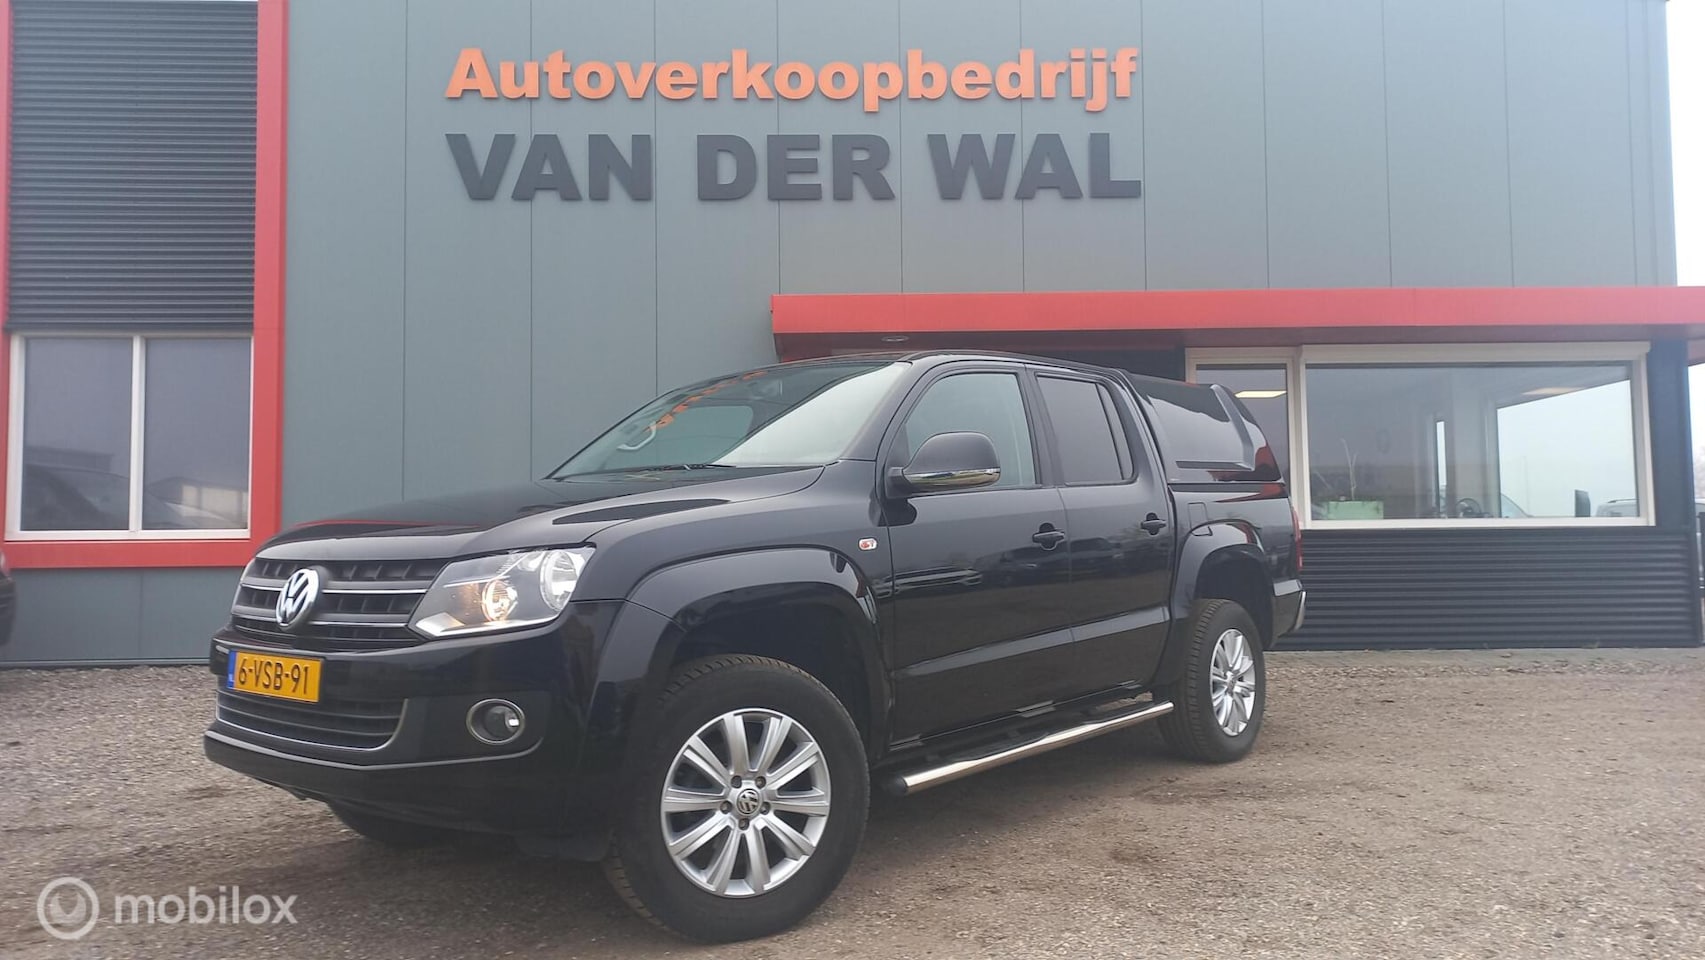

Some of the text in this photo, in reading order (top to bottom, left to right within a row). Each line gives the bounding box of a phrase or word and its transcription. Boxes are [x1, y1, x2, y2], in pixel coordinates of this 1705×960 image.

[445, 48, 1139, 112] Autoverkoopbedrijf
[445, 132, 1142, 201] VAN DER WAL
[238, 657, 310, 695] 6-VSB-91
